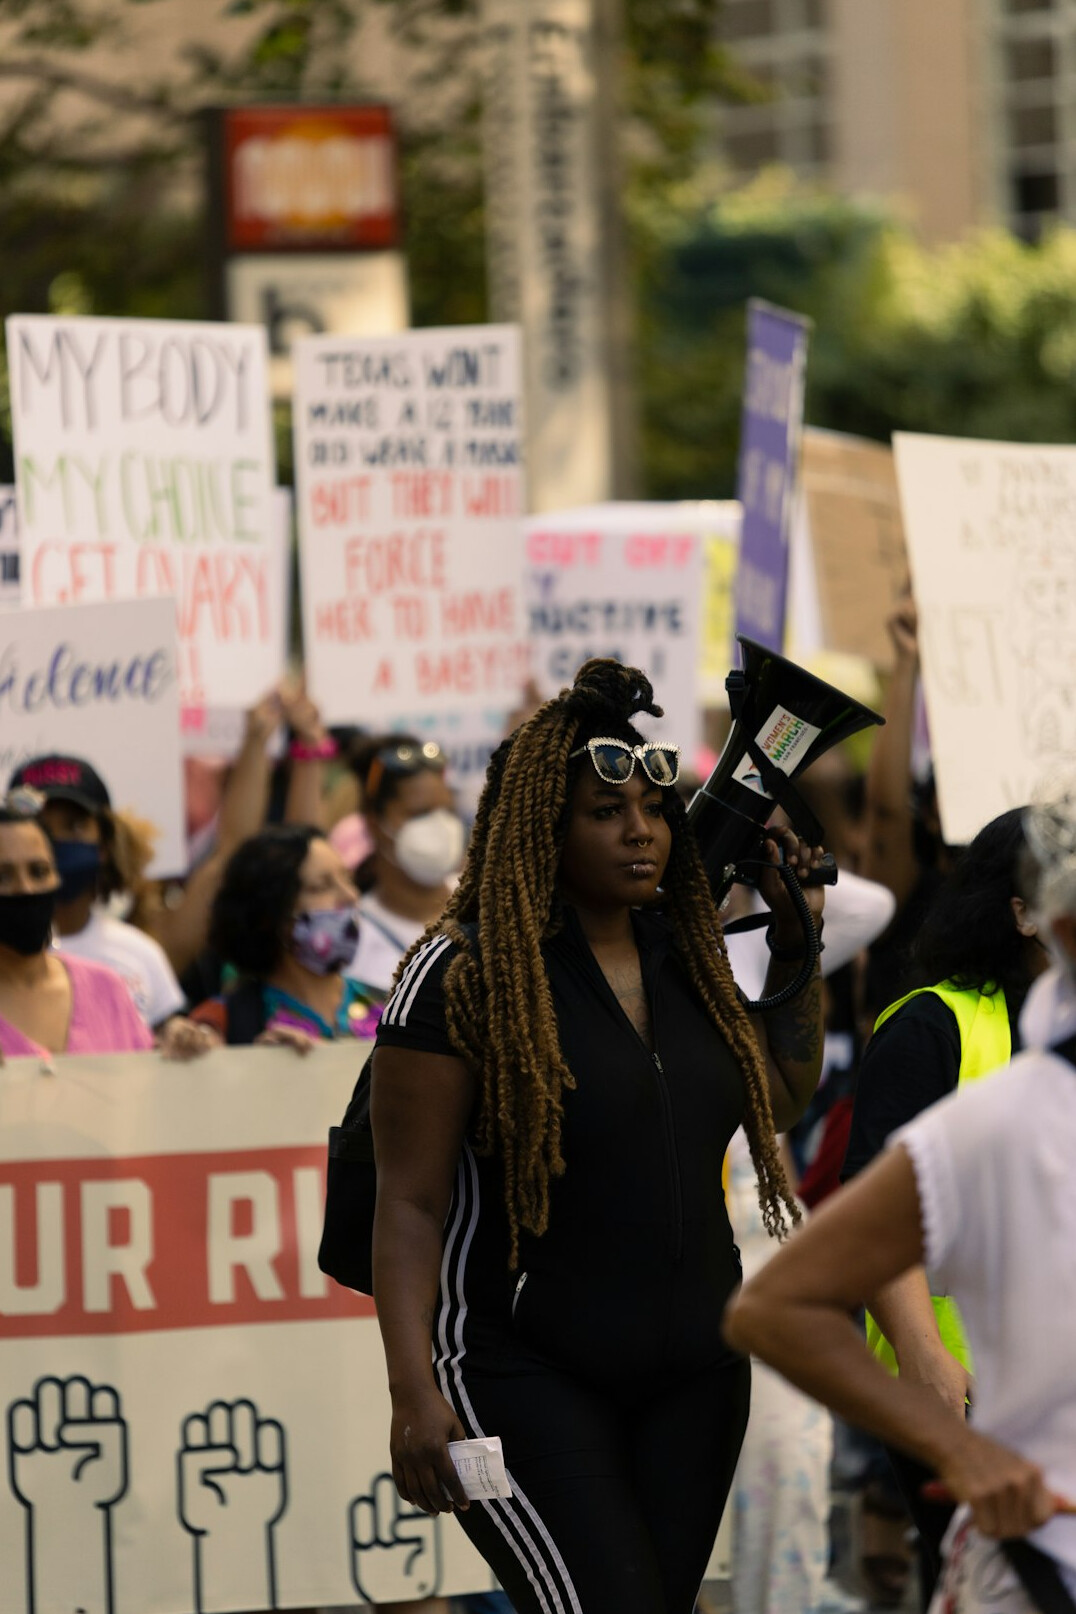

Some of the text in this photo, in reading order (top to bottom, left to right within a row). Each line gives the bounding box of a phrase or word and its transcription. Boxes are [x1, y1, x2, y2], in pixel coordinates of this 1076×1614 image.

[18, 330, 255, 435] MY BODY
[22, 454, 111, 536] MY
[310, 475, 371, 528] BUT
[388, 472, 454, 518] THEY
[343, 526, 448, 594] FORCE
[315, 585, 516, 644] HER TO HAVE
[371, 655, 397, 696] A
[762, 714, 791, 751] WOMEN'S
[768, 717, 804, 761] MARCH
[0, 1177, 157, 1316] UR
